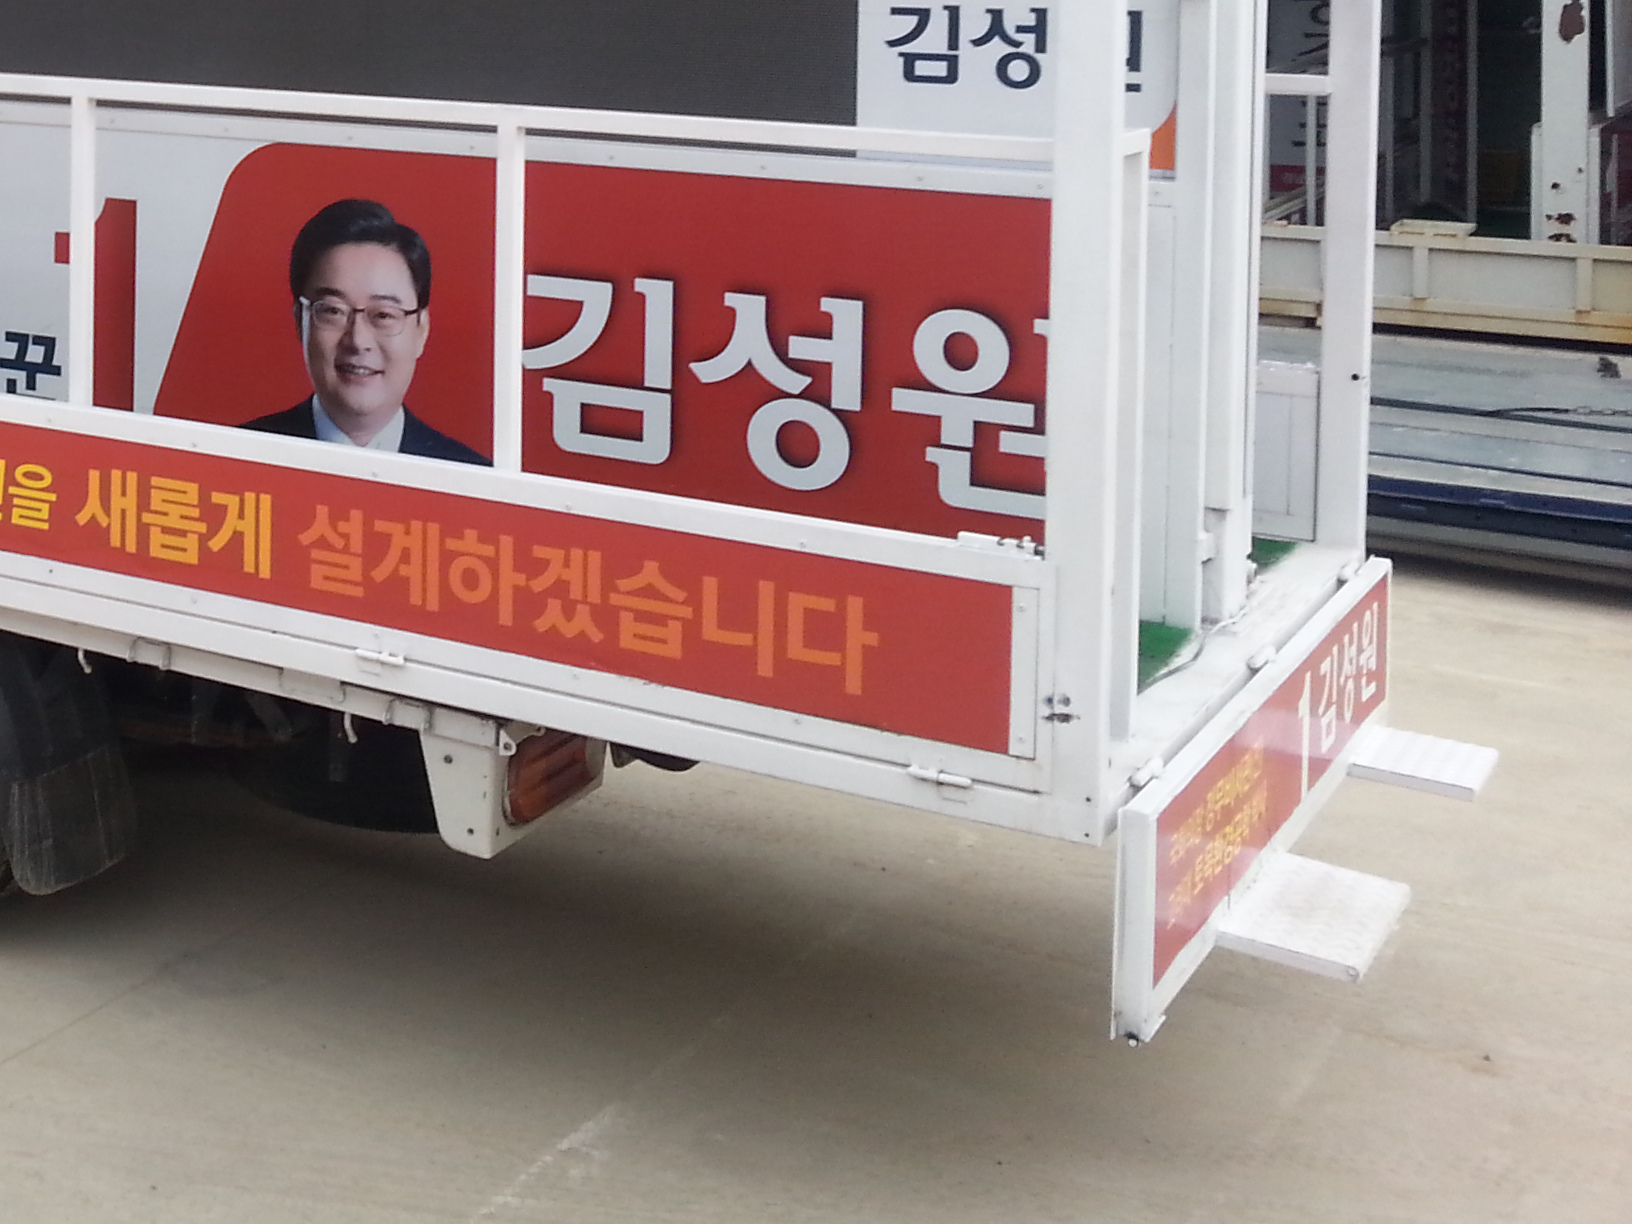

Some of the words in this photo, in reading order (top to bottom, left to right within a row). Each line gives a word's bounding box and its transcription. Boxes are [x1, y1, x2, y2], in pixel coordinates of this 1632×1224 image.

[522, 274, 1049, 520] 김성원
[75, 468, 271, 579] 새롭게
[298, 504, 879, 696] 설계하겠습니다
[1299, 671, 1311, 802] 1
[1319, 602, 1378, 754] 김성원
